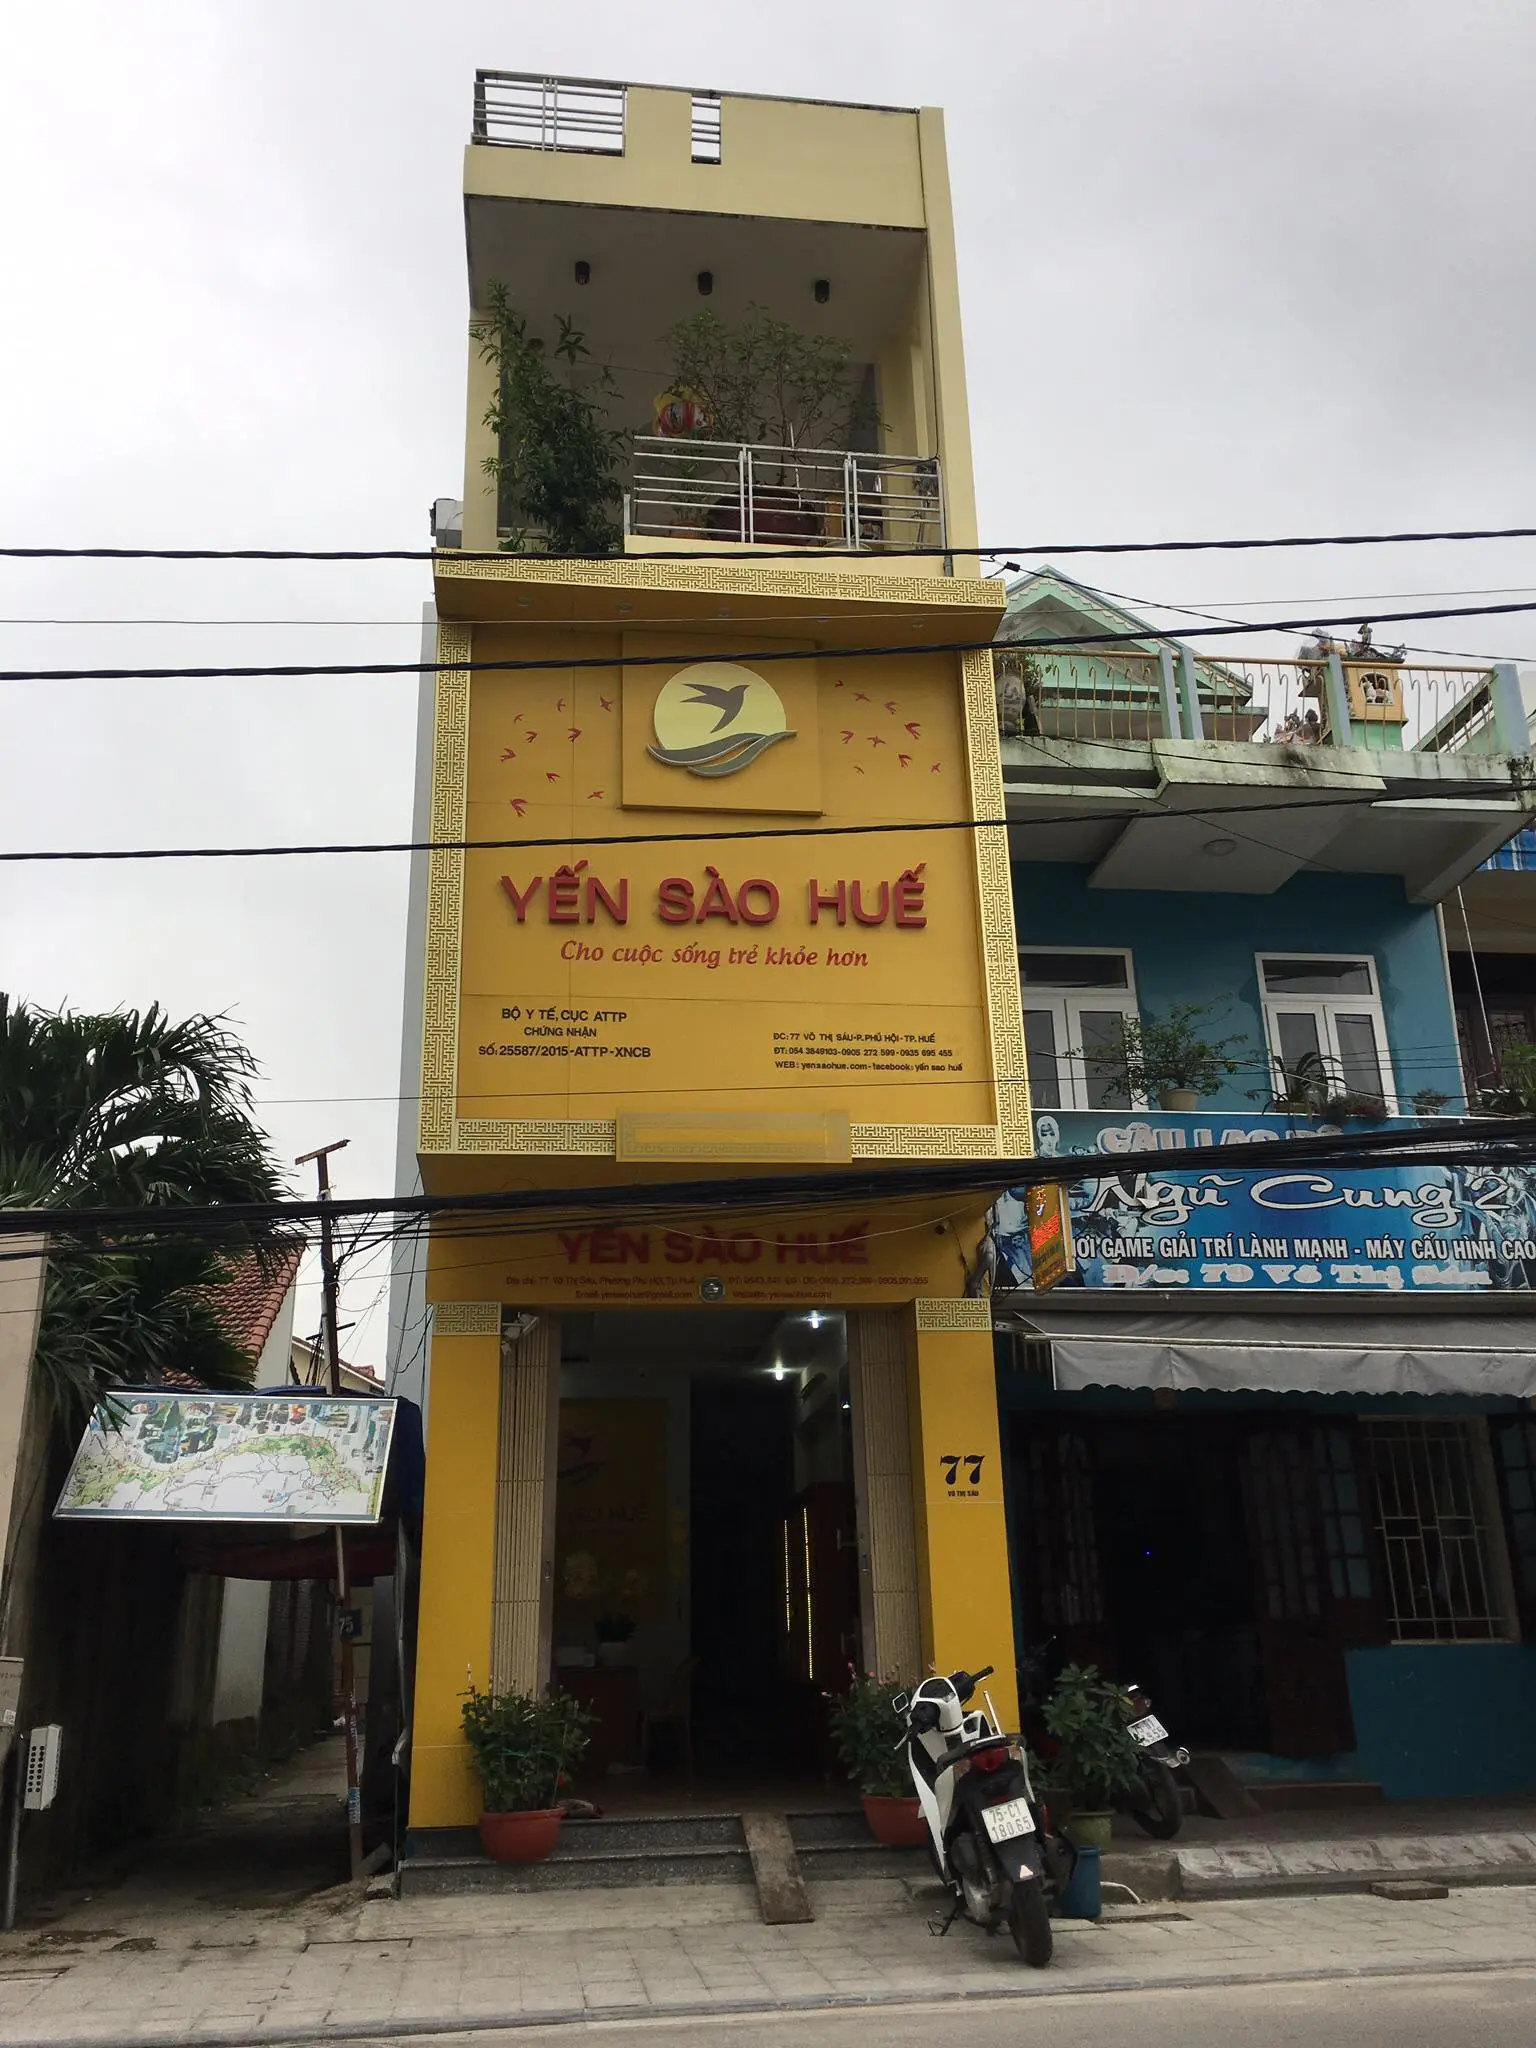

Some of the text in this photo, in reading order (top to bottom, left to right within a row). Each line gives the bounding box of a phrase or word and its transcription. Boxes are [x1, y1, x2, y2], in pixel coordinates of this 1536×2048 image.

[500, 860, 928, 928] YẾN SÀO HUẾ
[560, 939, 870, 970] Cho cuộc sống trẻ khỏe hơn
[502, 1006, 521, 1022] BỘ
[526, 1009, 535, 1019] Y
[561, 1010, 588, 1022] CỤC
[593, 1011, 628, 1023] ATTP
[863, 1049, 878, 1057] 272
[938, 1049, 953, 1057] 455
[1086, 1174, 1244, 1227] Ngũ
[1250, 1174, 1462, 1227] Cung
[1470, 1175, 1514, 1211] 2
[664, 1224, 762, 1265] SÀO
[776, 1219, 870, 1265] HUẾ
[1101, 1237, 1154, 1259] GAME
[1160, 1231, 1197, 1260] GIẢI
[1201, 1233, 1233, 1260] TRÍ
[1238, 1232, 1289, 1260] LÀNH
[1294, 1239, 1349, 1262] MẠNH
[1365, 1235, 1405, 1260] MÁY
[1411, 1233, 1448, 1261] CẤU
[1452, 1235, 1497, 1261] HÌNH
[1501, 1239, 1536, 1261] CAO
[940, 1454, 985, 1485] 77
[990, 1801, 1021, 1823] 75-C1
[992, 1815, 1032, 1840] 180.65
